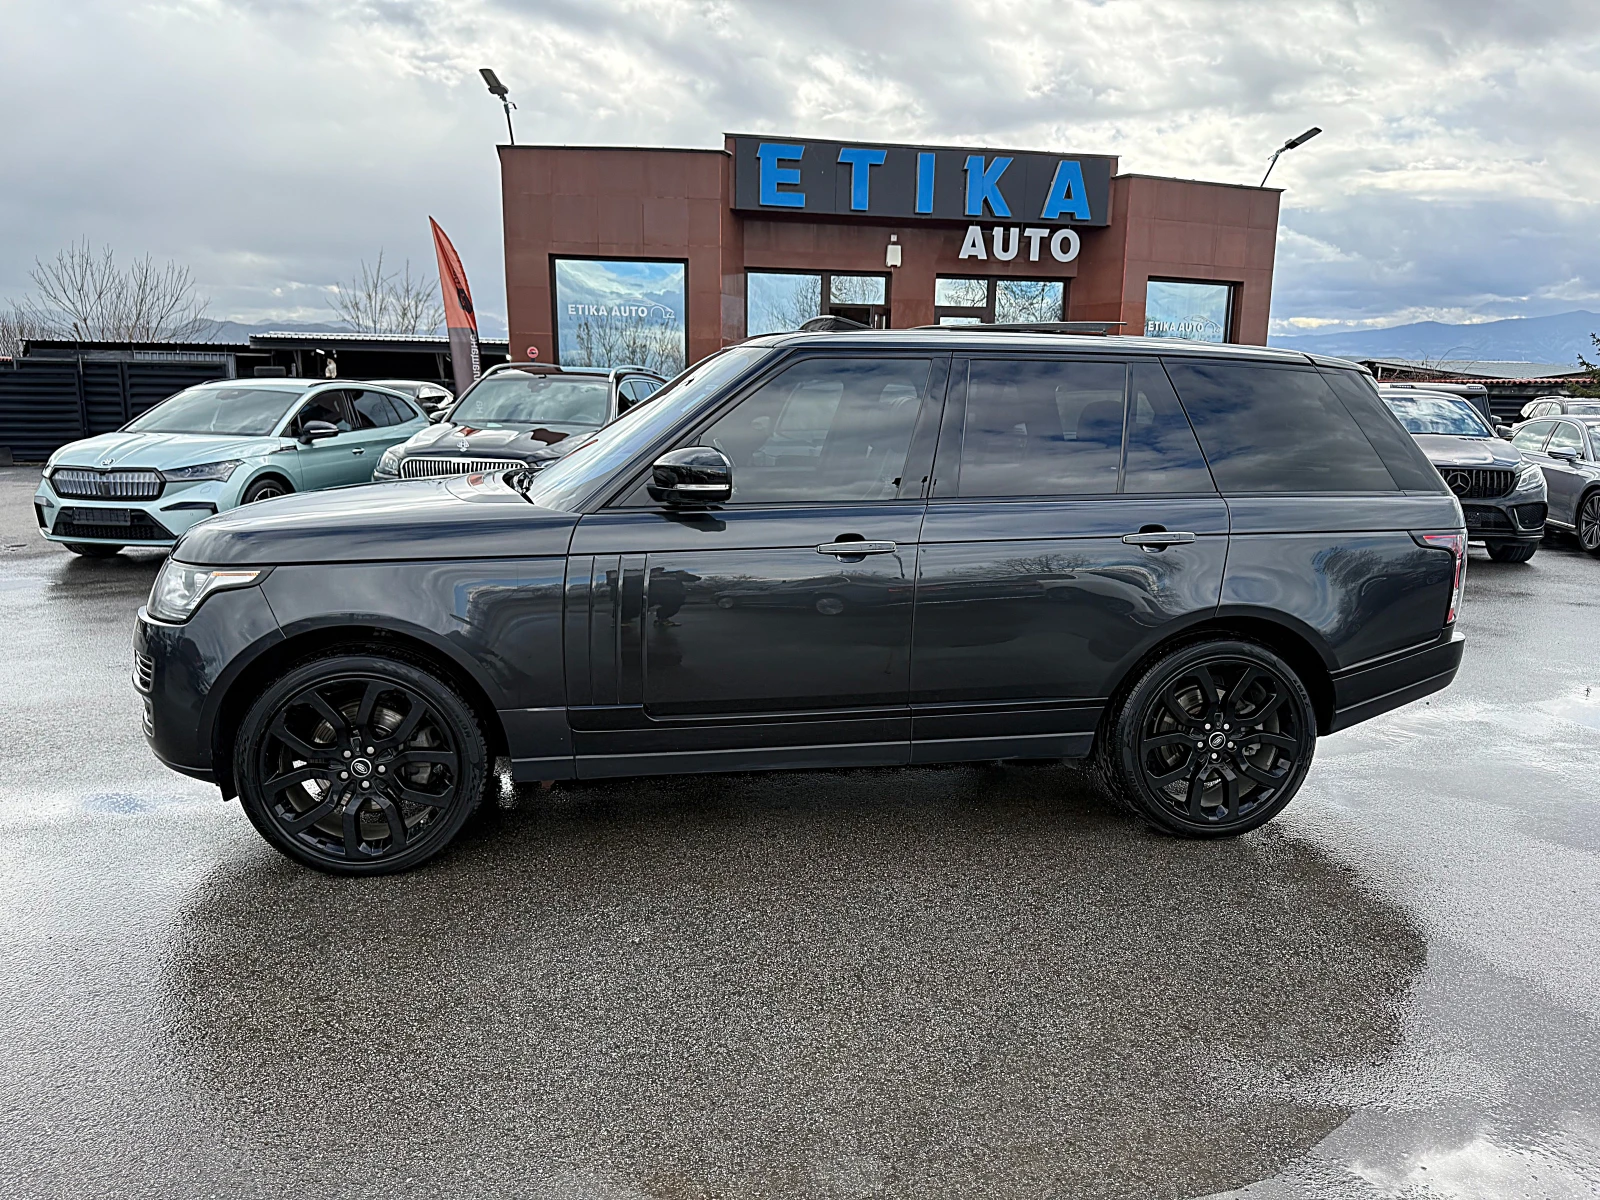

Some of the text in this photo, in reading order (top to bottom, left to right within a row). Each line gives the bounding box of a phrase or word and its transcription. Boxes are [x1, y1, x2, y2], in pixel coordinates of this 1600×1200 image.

[757, 143, 1091, 220] ETIKA
[959, 225, 1080, 263] AUTO
[568, 304, 648, 317] ETIKA AUTO
[1148, 321, 1204, 332] ETIKA AUTO
